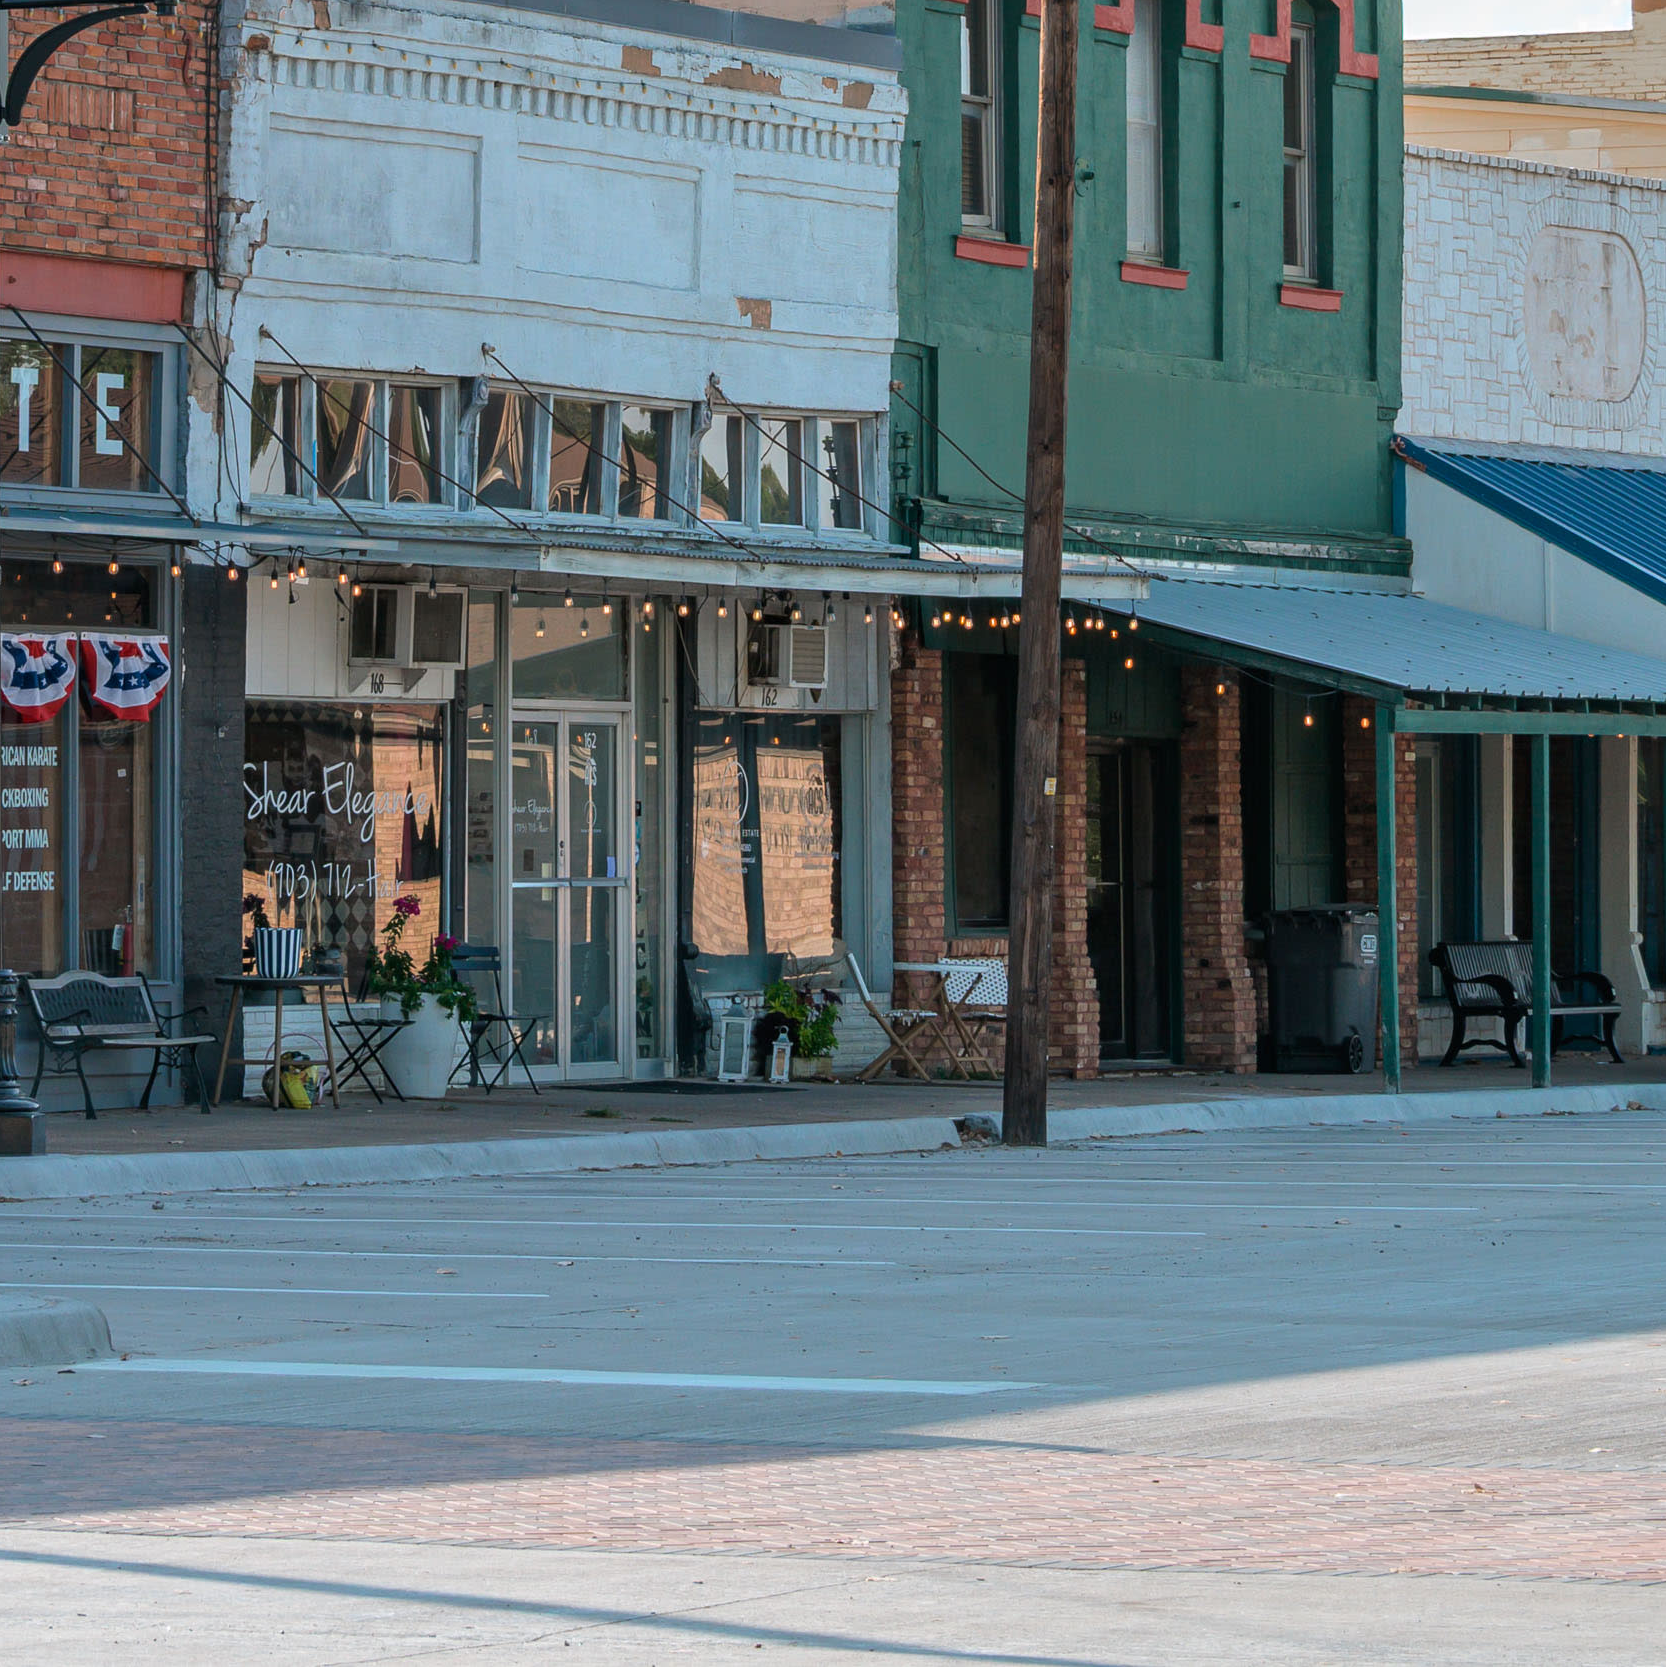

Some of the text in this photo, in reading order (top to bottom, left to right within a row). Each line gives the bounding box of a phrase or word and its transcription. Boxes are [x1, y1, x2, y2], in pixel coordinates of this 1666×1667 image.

[370, 672, 384, 695] 168
[761, 687, 778, 707] 162
[27, 745, 58, 766] KARATE
[1, 787, 49, 809] CKBOXING
[243, 760, 431, 844] Shear Elegance
[25, 828, 49, 849] MMA
[14, 870, 55, 892] DEFENSE
[267, 859, 318, 903] (903)
